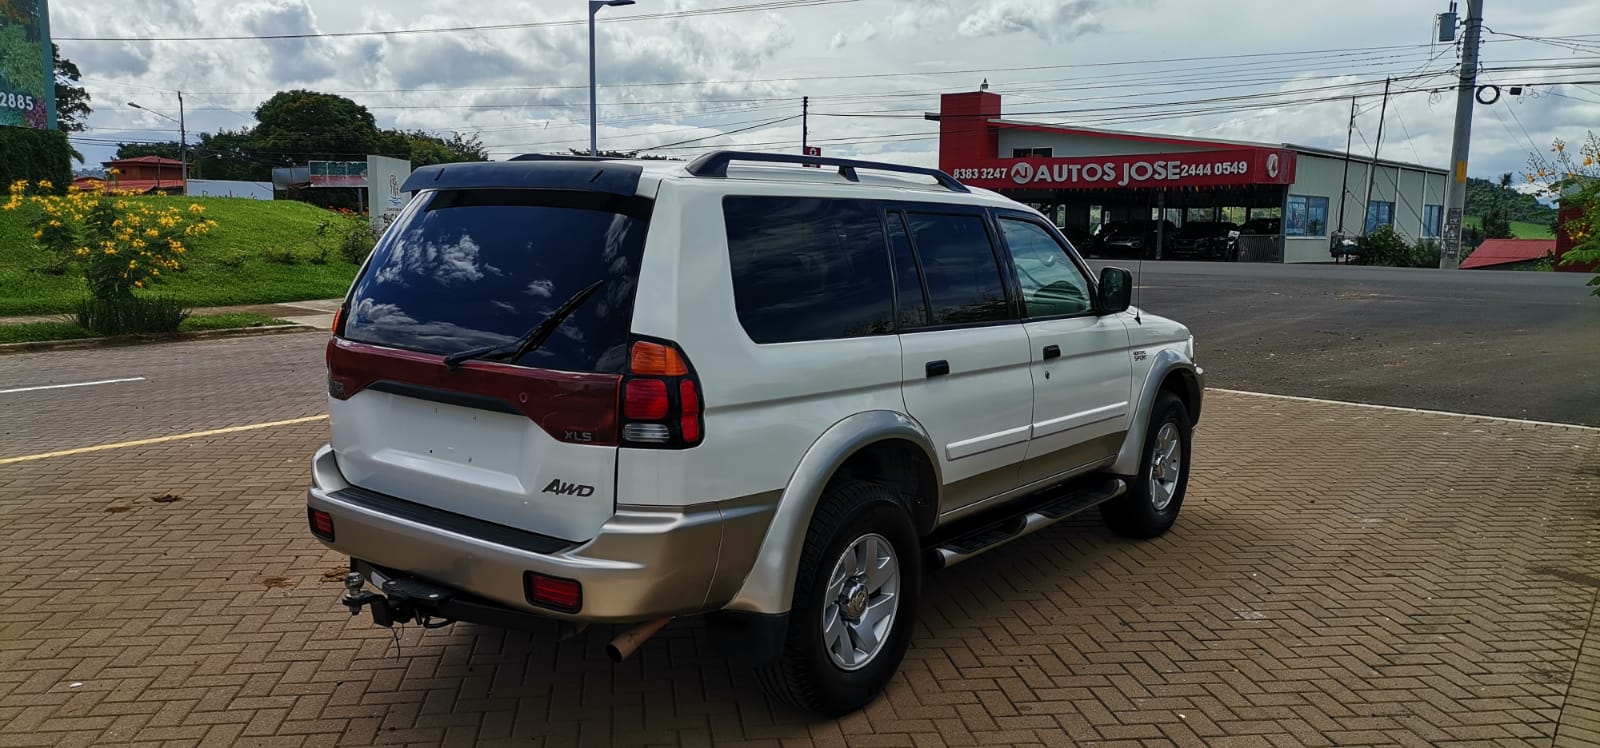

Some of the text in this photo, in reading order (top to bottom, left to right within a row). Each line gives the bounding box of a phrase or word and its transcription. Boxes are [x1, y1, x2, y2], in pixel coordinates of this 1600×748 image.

[0, 91, 34, 111] 2885
[953, 167, 1008, 180] 8383 3247
[1034, 160, 1181, 186] AUTOS JOSE
[1180, 160, 1248, 177] 2444 0549
[564, 430, 592, 441] XLS
[542, 478, 595, 497] AWD
